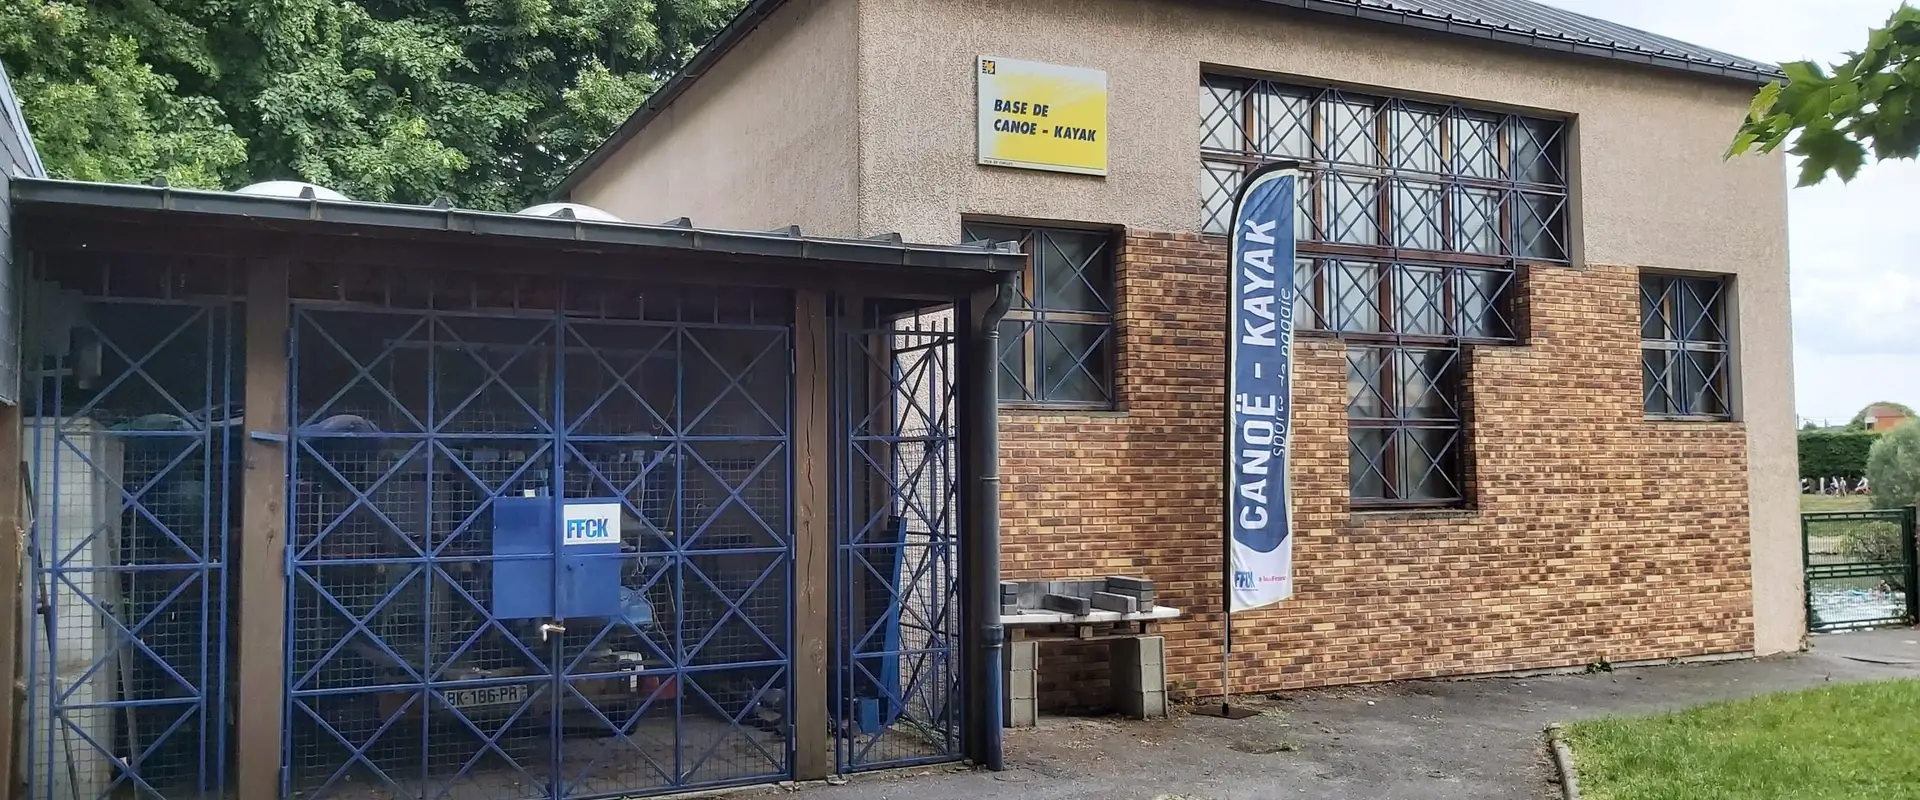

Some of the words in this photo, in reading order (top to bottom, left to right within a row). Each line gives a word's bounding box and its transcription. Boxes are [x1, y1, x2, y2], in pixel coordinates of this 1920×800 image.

[994, 99, 1028, 115] BASE
[1033, 103, 1049, 117] DE
[994, 119, 1037, 135] CANOE
[1054, 126, 1097, 142] KAYAK
[1242, 219, 1276, 347] KAYAK
[1236, 392, 1276, 530] CANOË
[567, 518, 609, 539] FFCK
